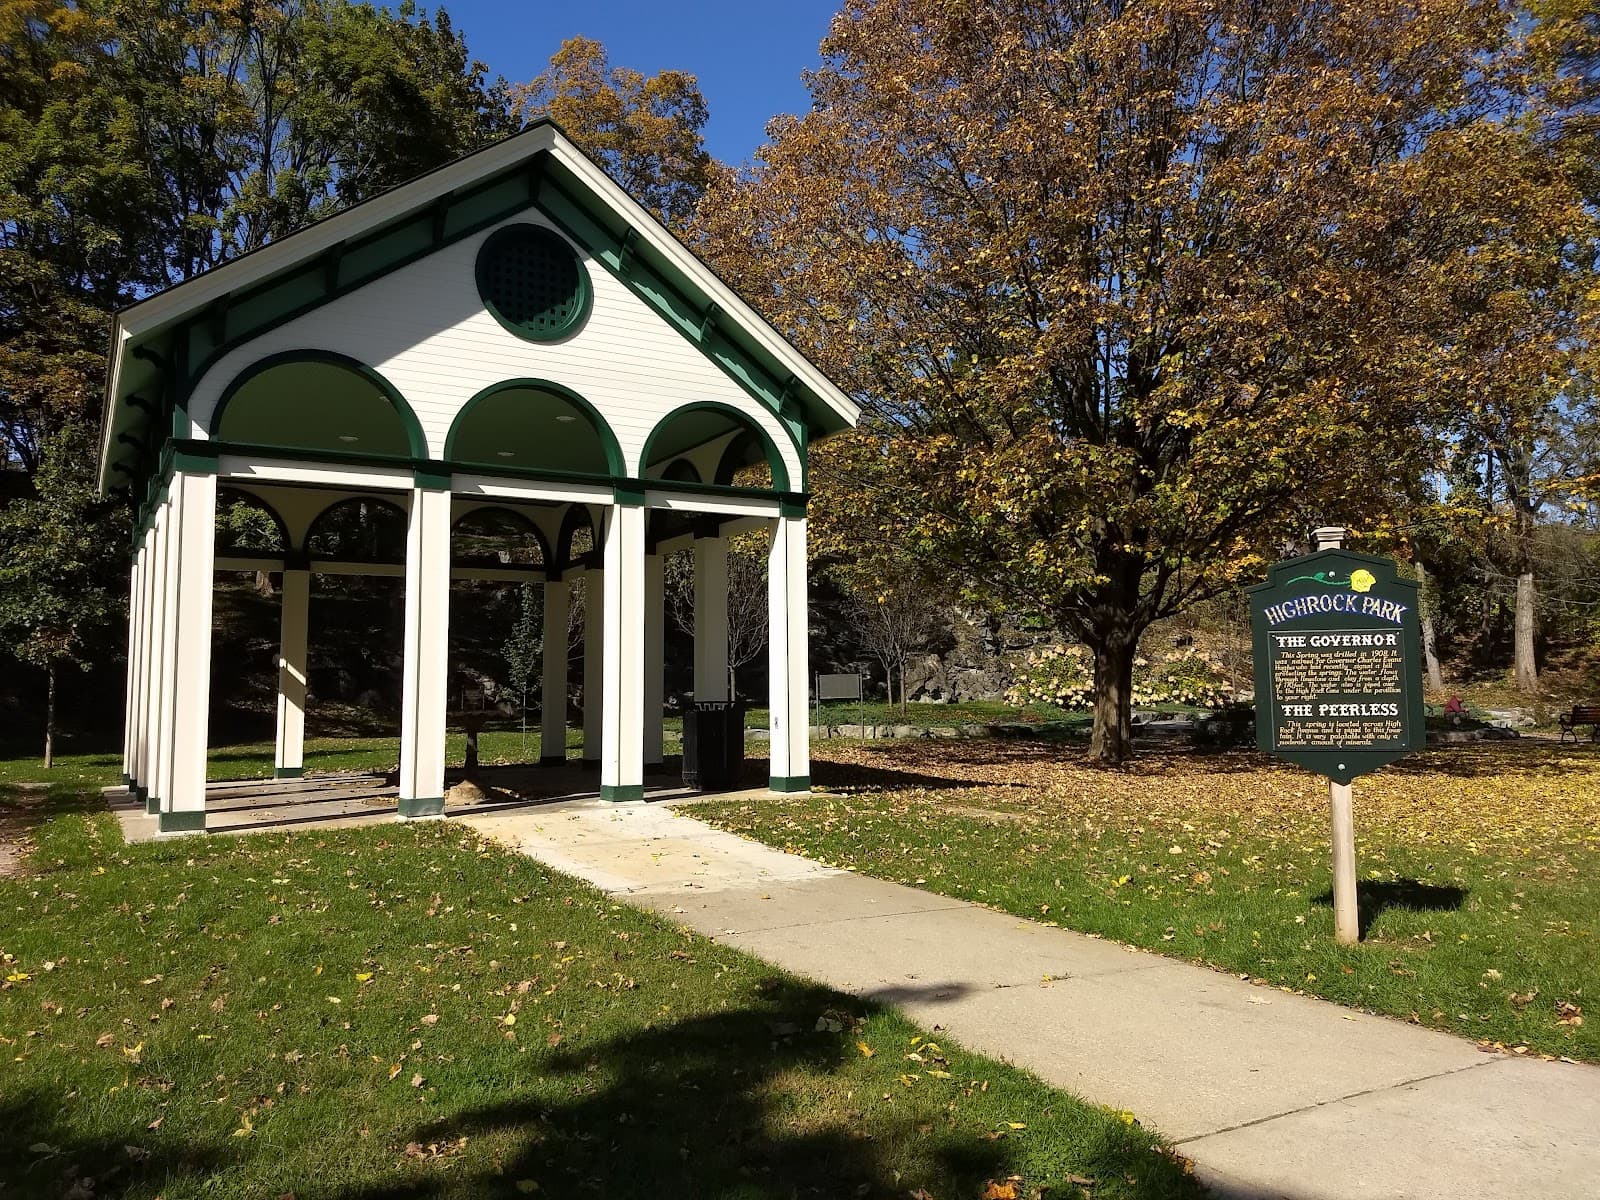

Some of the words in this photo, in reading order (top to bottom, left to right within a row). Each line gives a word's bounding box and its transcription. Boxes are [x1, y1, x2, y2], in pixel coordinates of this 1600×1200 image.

[1362, 597, 1407, 624] PARK
[1275, 636, 1307, 648] THE
[1310, 634, 1397, 648] GOVERNOR
[1296, 651, 1320, 660] Spring
[1378, 668, 1398, 676] flows
[1296, 687, 1309, 695] High
[1300, 694, 1318, 702] right.
[1281, 704, 1313, 716] THE
[1319, 703, 1398, 716] PEERLESS
[1305, 721, 1327, 729] spring
[1385, 720, 1401, 728] High
[1280, 726, 1294, 734] Rock
[1296, 726, 1319, 734] Avenue
[1344, 727, 1361, 735] piped
[1330, 733, 1361, 741] palatable
[1336, 739, 1343, 747] of
